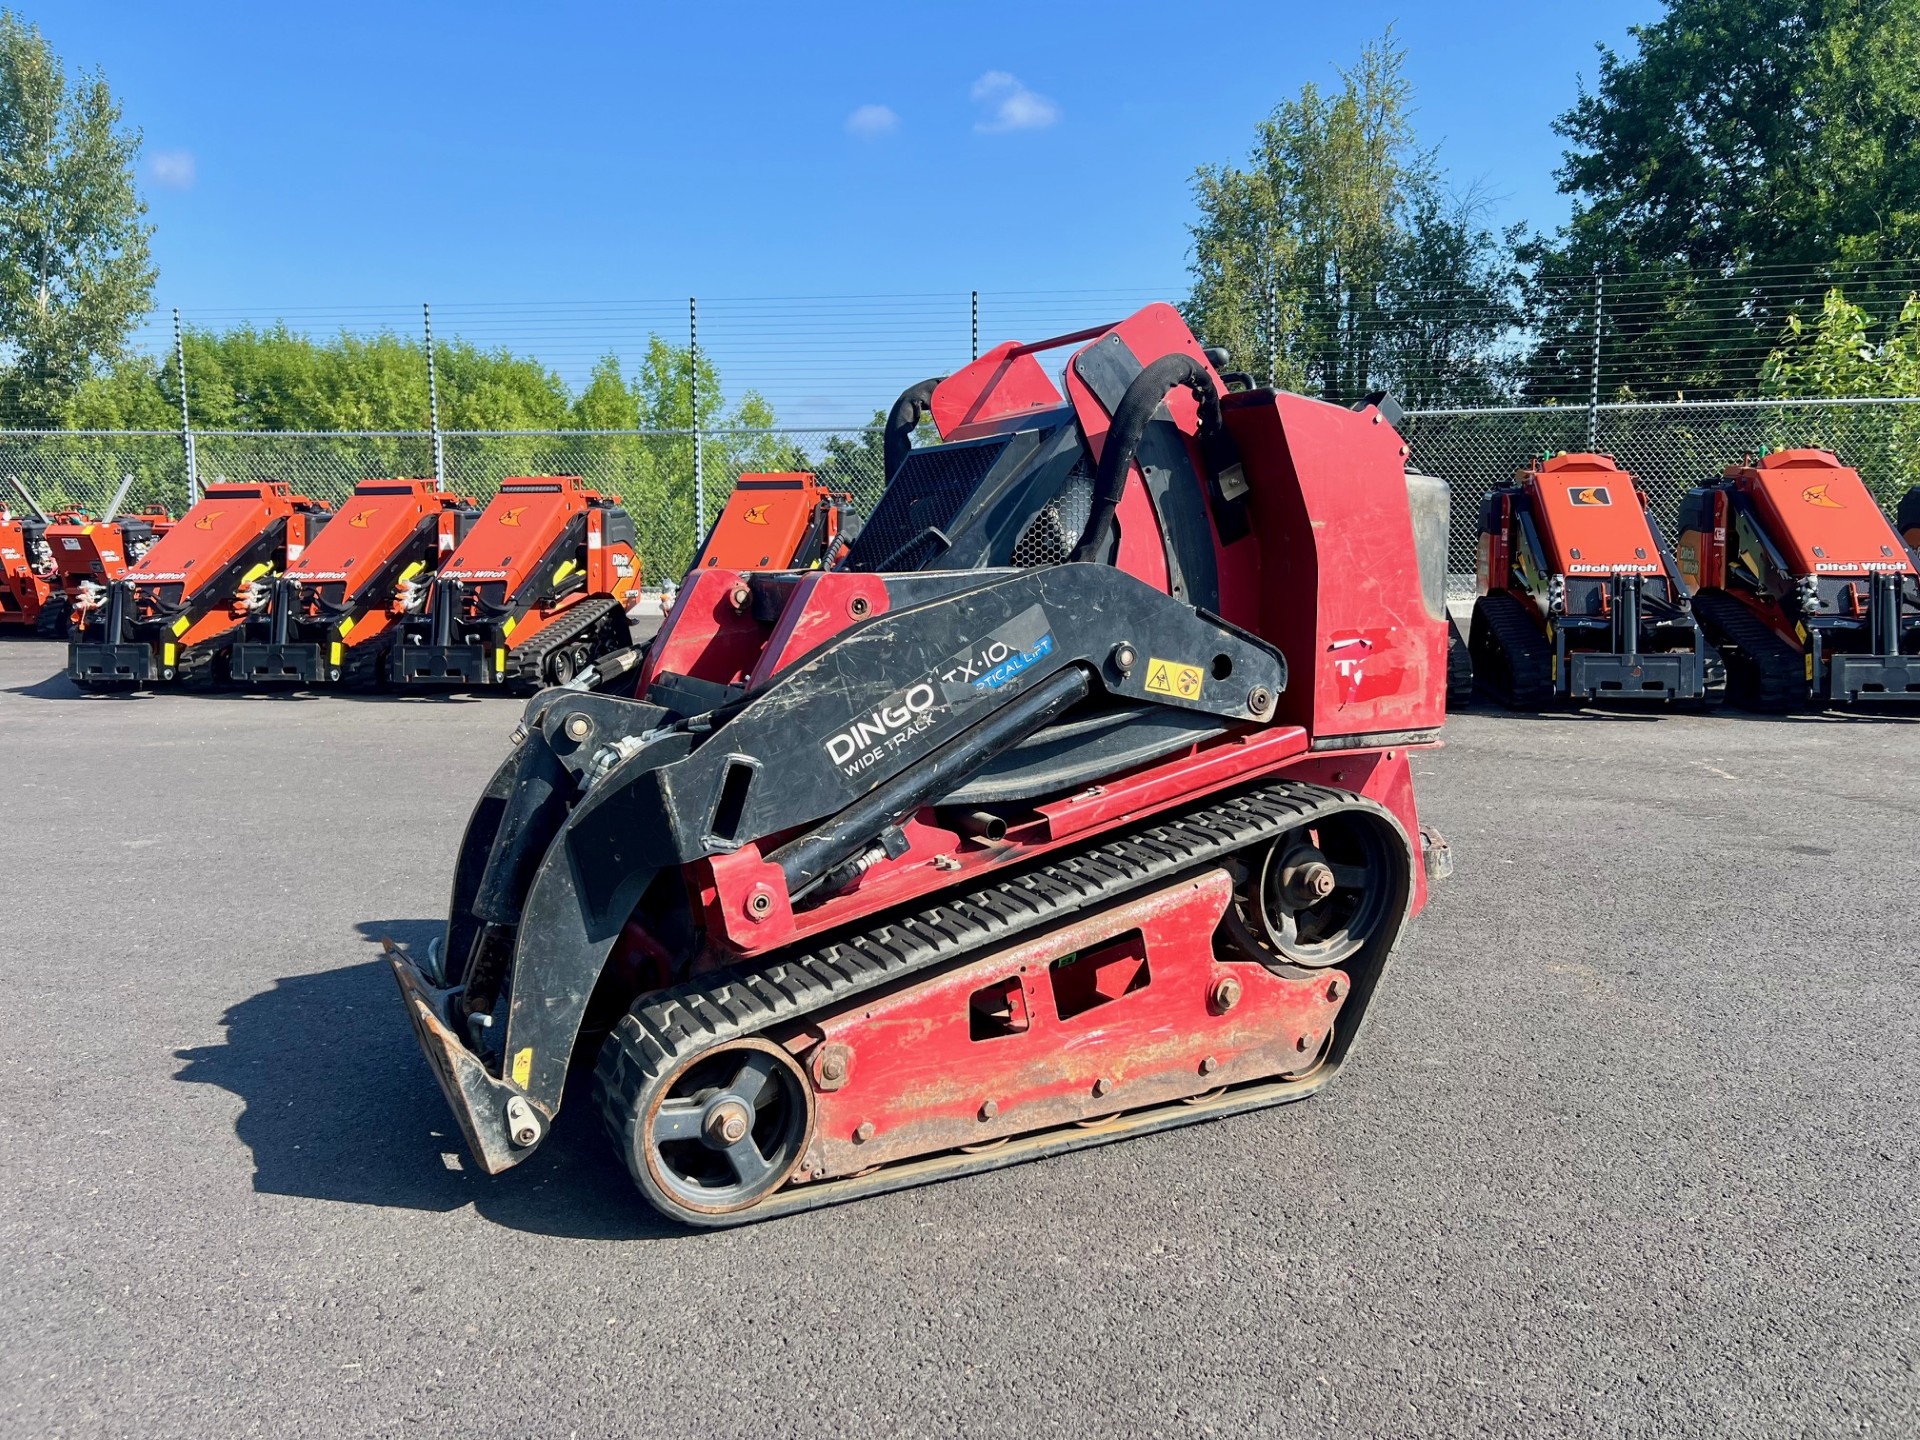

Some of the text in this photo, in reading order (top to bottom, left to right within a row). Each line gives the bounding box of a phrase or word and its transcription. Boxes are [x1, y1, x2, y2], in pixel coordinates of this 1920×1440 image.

[612, 553, 629, 566] Ditch
[1569, 563, 1659, 573] Ditch Witch
[1815, 562, 1907, 571] Ditch Witch
[125, 572, 187, 580] Ditch Witch
[284, 571, 348, 579] Ditch Witch
[441, 570, 509, 578] Ditch Witch
[617, 566, 634, 578] Witch
[825, 683, 935, 766] DINGO
[843, 712, 937, 777] WIDE TRACK
